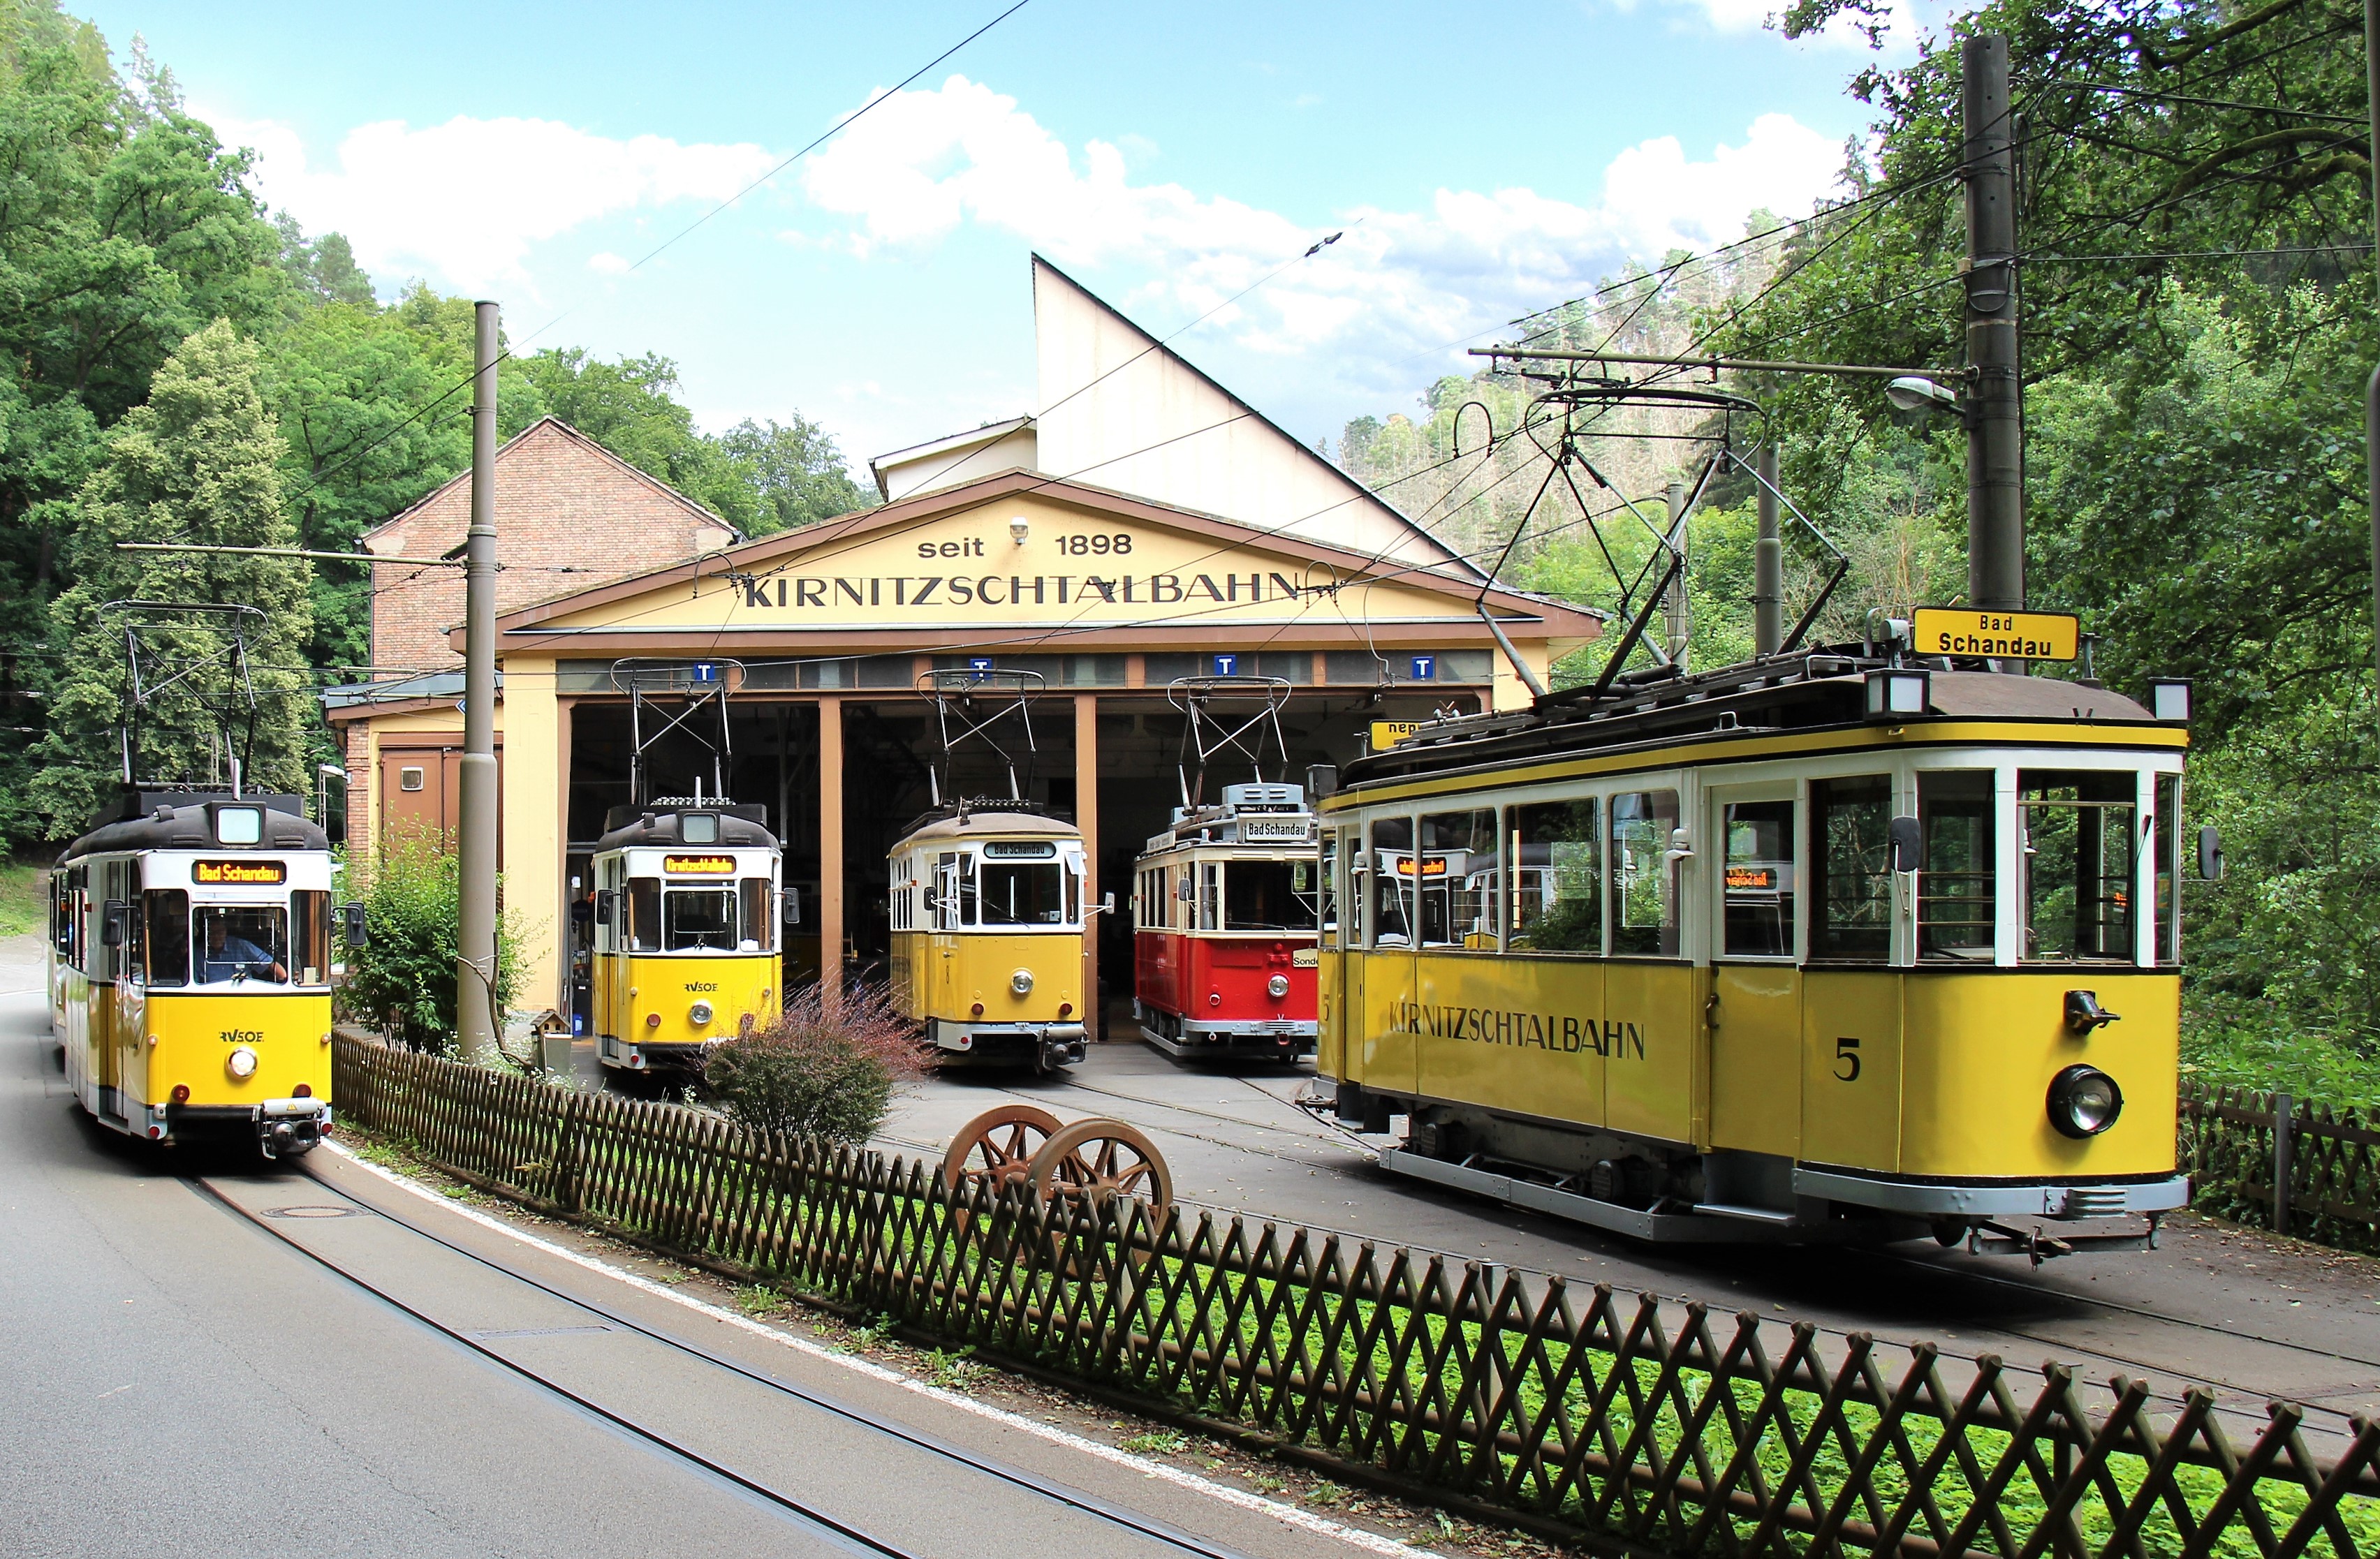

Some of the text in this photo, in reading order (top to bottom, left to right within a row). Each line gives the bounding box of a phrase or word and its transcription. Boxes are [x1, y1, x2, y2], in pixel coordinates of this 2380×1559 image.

[918, 533, 1132, 558] seit 1898
[746, 572, 1299, 607] KIRNITZSCHTALBAHN
[1979, 614, 2012, 631] Bad
[1939, 632, 2051, 656] Schandau
[697, 664, 712, 681] T
[974, 661, 987, 678] T
[1218, 658, 1233, 675] T
[1416, 659, 1430, 676] T
[1249, 822, 1305, 836] Bad Schandau
[994, 843, 1045, 855] Bad Schandau
[198, 863, 279, 882] Bad Schandau
[1293, 956, 1318, 966] Sond
[1389, 1000, 1645, 1061] KIRNITZSCHTALBAHN
[1832, 1037, 1861, 1082] 5
